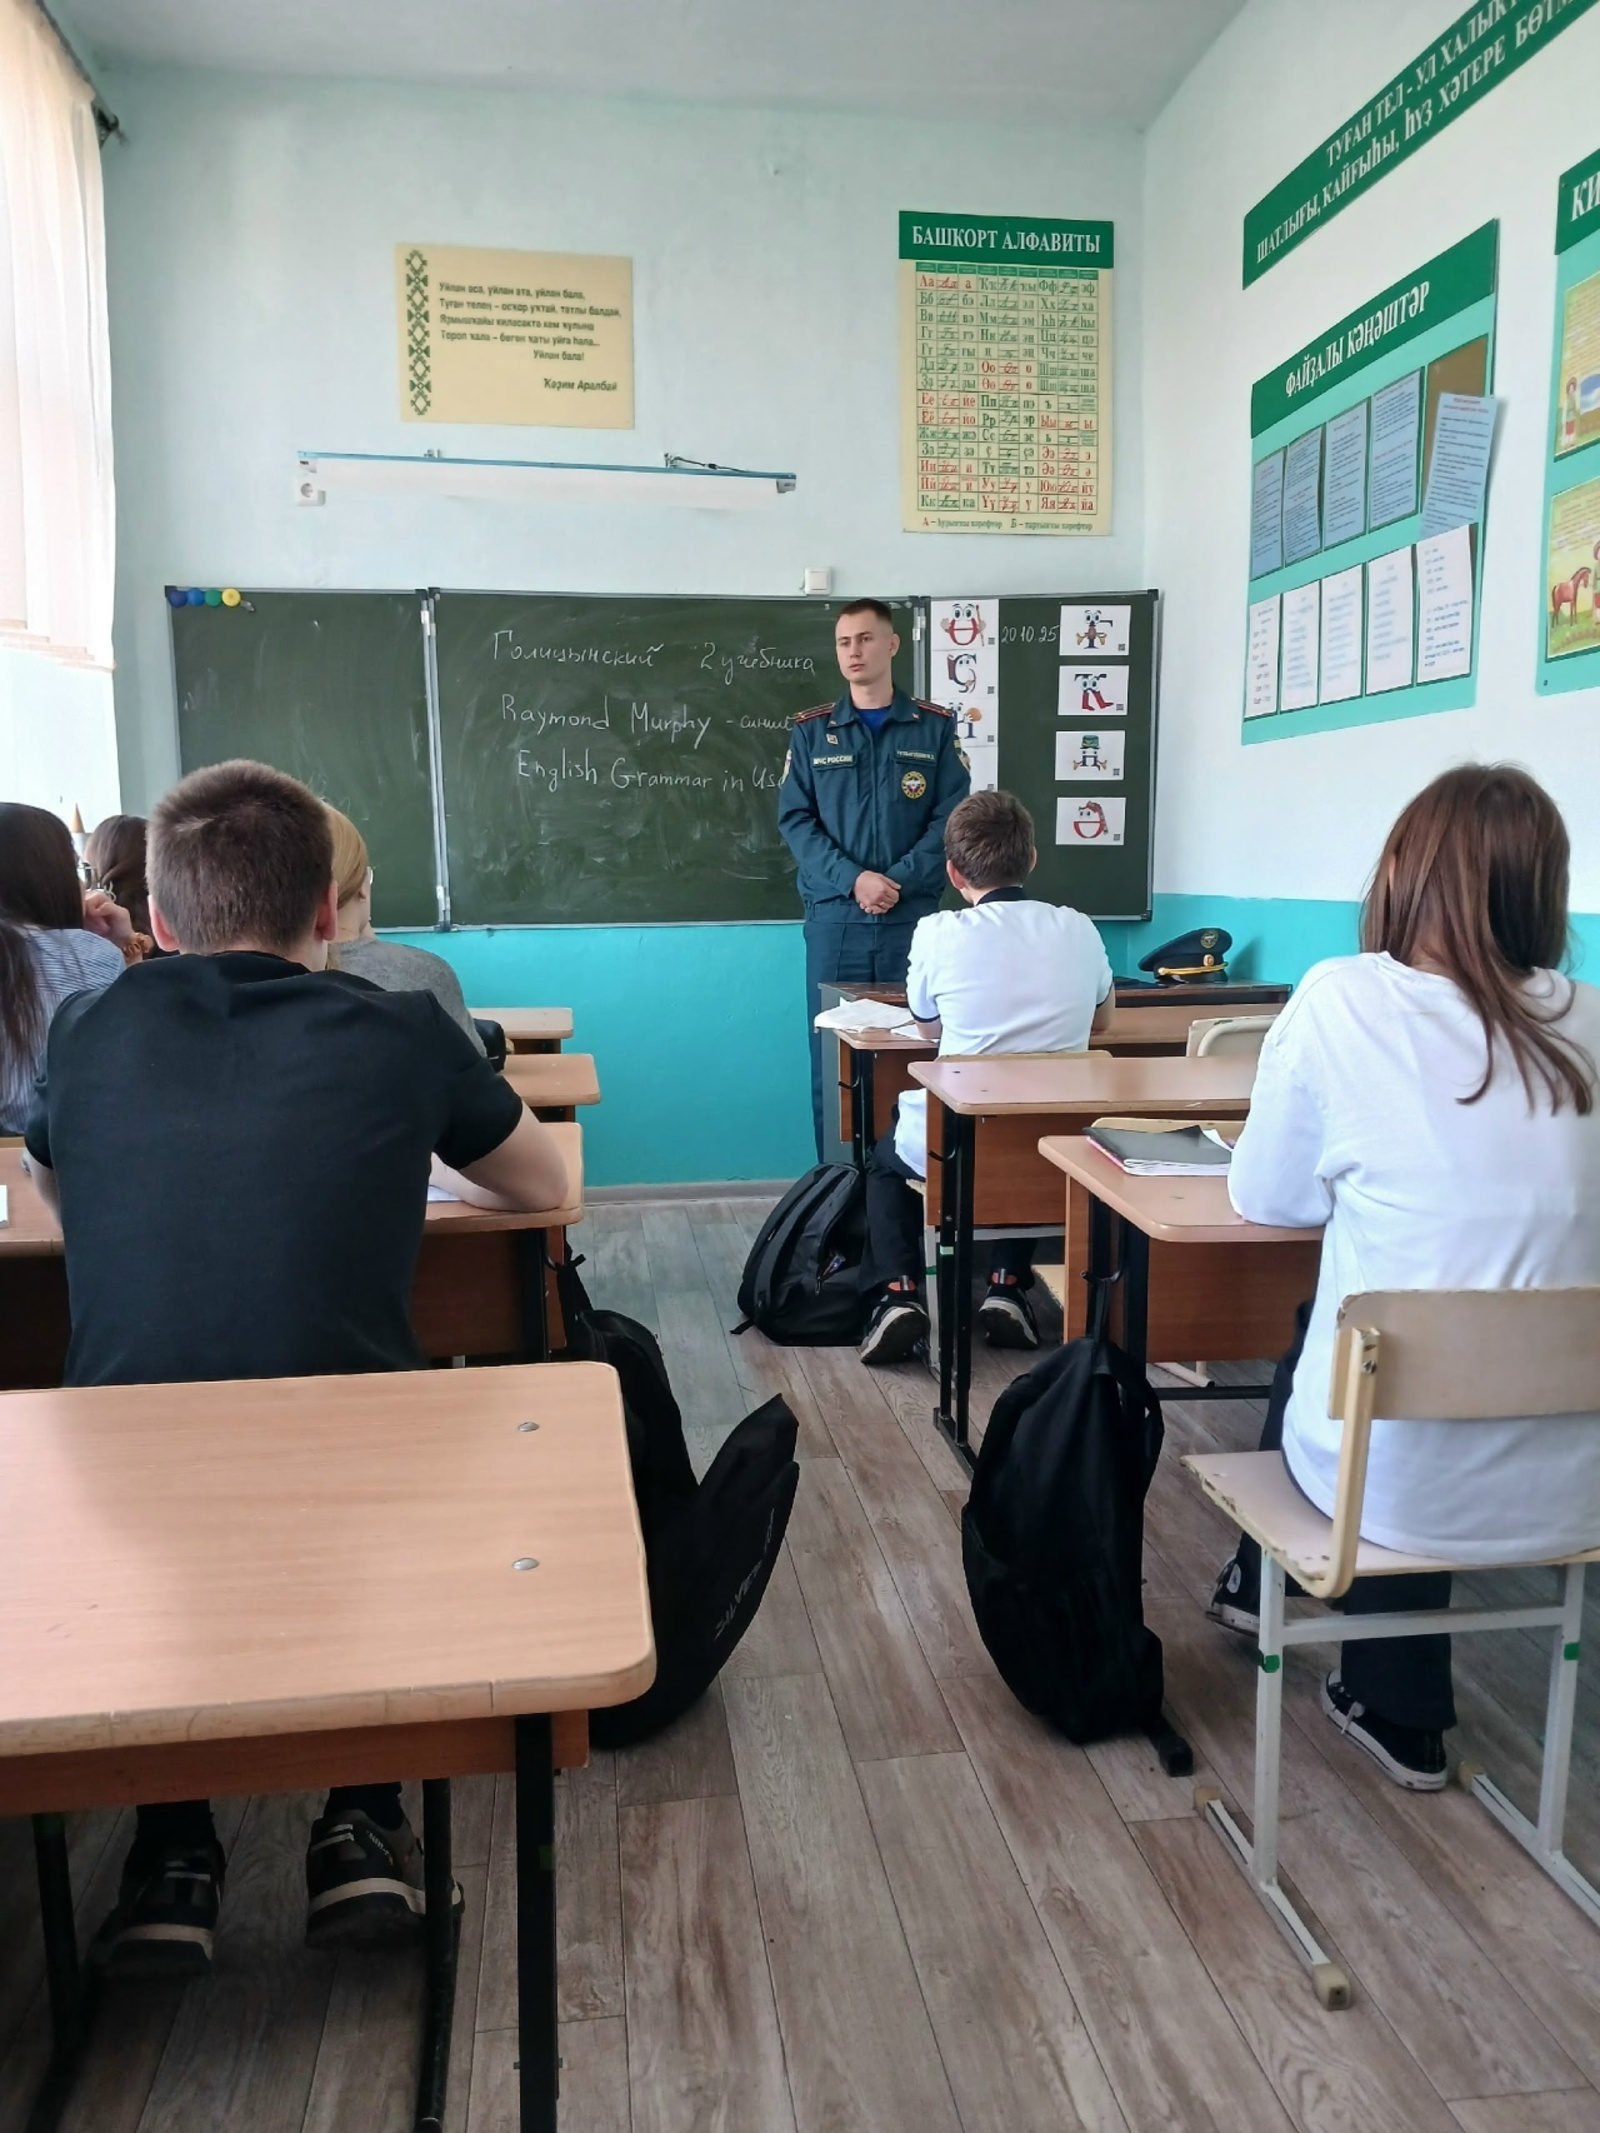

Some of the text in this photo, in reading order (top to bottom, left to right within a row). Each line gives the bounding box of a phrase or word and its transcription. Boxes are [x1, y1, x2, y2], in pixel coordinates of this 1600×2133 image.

[1375, 82, 1403, 126] ТЕЛ
[1416, 53, 1436, 91] УЛ
[1438, 34, 1506, 115] ХӘТЕРЕ
[1001, 231, 1101, 253] АЛФАВИТЫ
[1346, 280, 1430, 359] КӘҢӘШТӘР
[493, 629, 816, 685] Голицынский 2 учебника
[502, 693, 610, 735] Raymond
[631, 701, 712, 750] Murphy
[518, 747, 598, 792] English
[610, 757, 713, 789] Grammar
[722, 769, 744, 792] in
